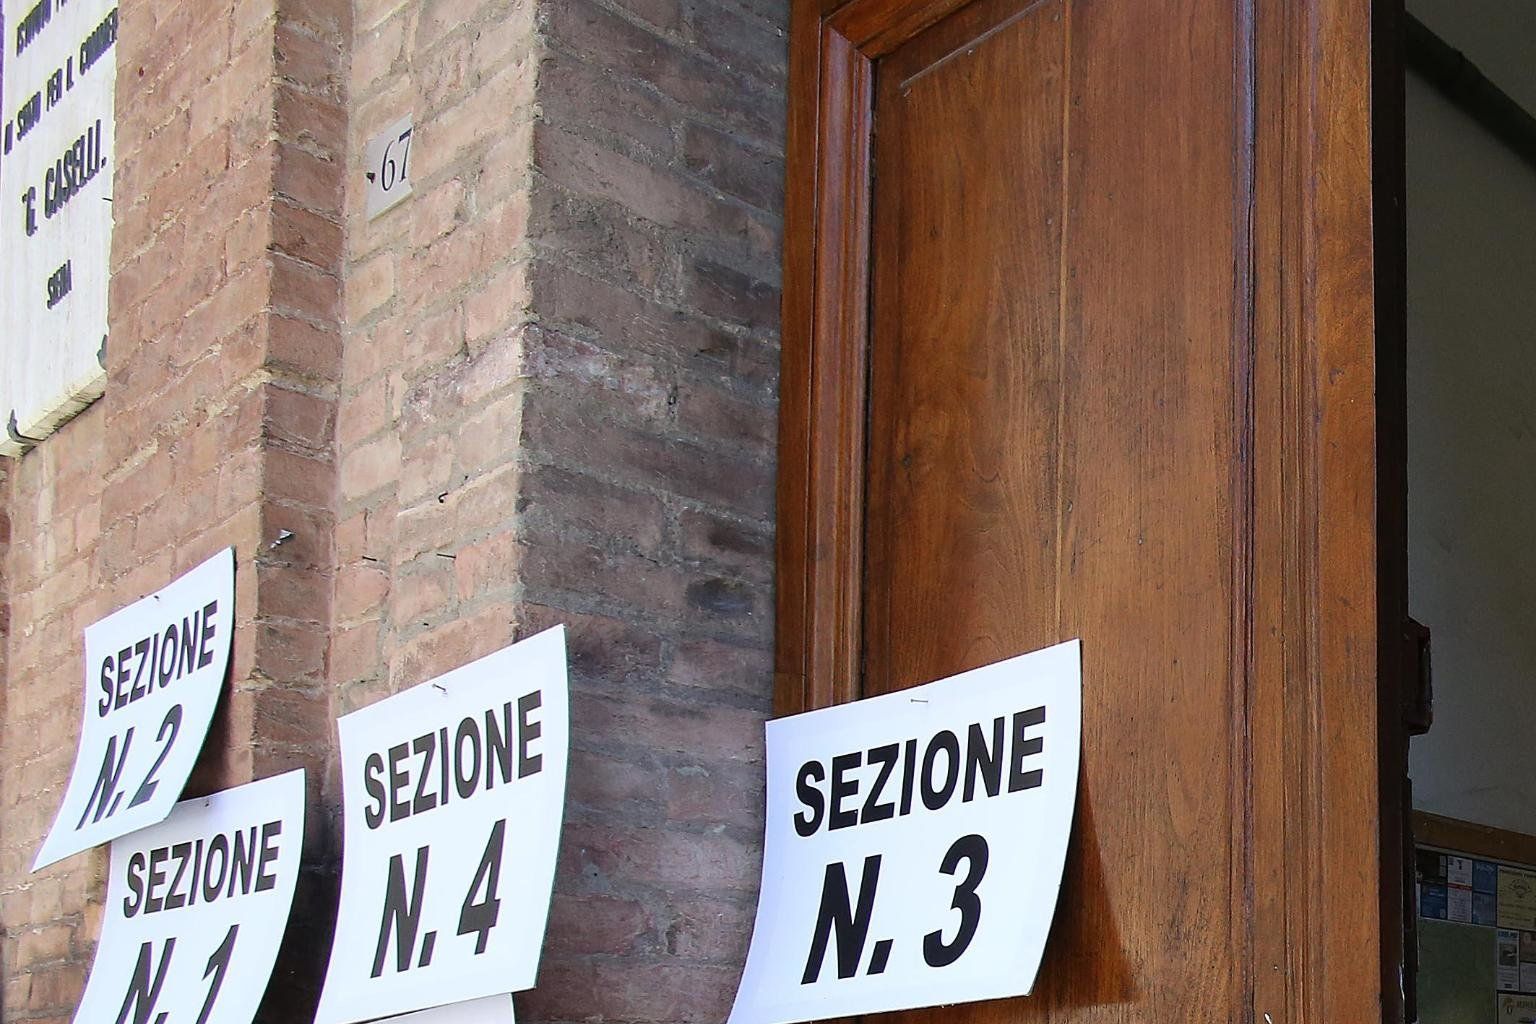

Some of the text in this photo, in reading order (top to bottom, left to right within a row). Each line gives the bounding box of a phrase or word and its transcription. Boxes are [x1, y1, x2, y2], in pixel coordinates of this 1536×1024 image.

[46, 68, 62, 112] PER
[66, 56, 74, 92] IL
[79, 7, 119, 76] COMMER
[381, 127, 413, 192] 67
[98, 599, 219, 719] SEZIONE
[75, 703, 183, 831] N. 2
[364, 689, 543, 830] SEZIONE
[793, 705, 1046, 838] SEZIONE
[123, 819, 283, 919] SEZIONE
[369, 818, 507, 979] N. 4
[800, 833, 990, 986] N. 3
